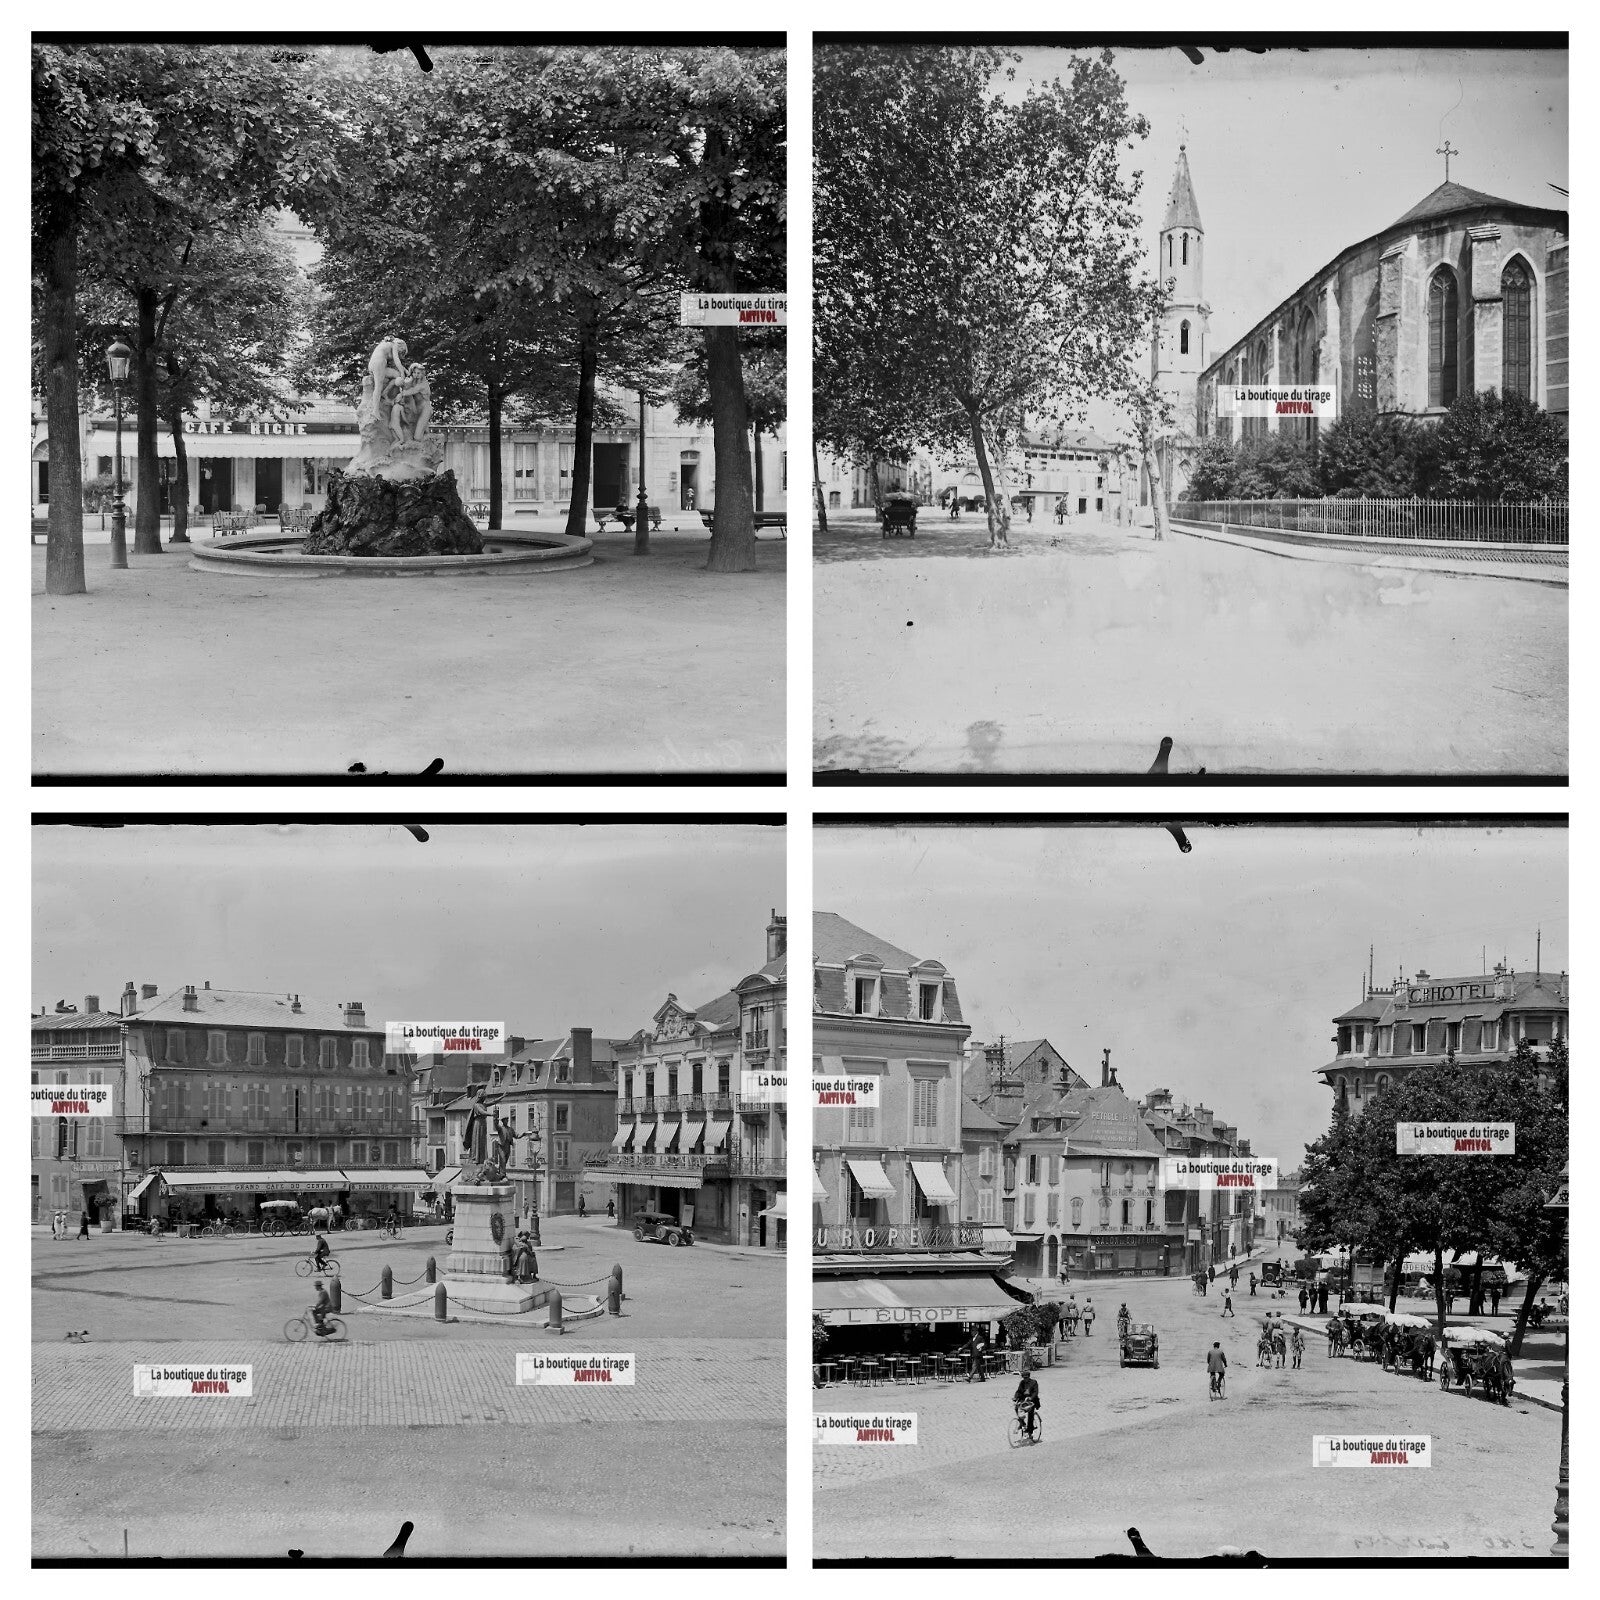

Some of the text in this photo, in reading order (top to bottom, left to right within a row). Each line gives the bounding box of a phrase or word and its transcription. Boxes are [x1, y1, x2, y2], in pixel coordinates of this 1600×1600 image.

[185, 422, 307, 436] CAFE RICHE
[1431, 985, 1496, 1001] HOTEL
[234, 1183, 260, 1191] GRAND
[306, 1182, 334, 1190] CENTRE
[816, 1228, 919, 1247] UROPE
[1402, 1262, 1435, 1272] ODERN
[876, 1308, 968, 1323] EUROPE
